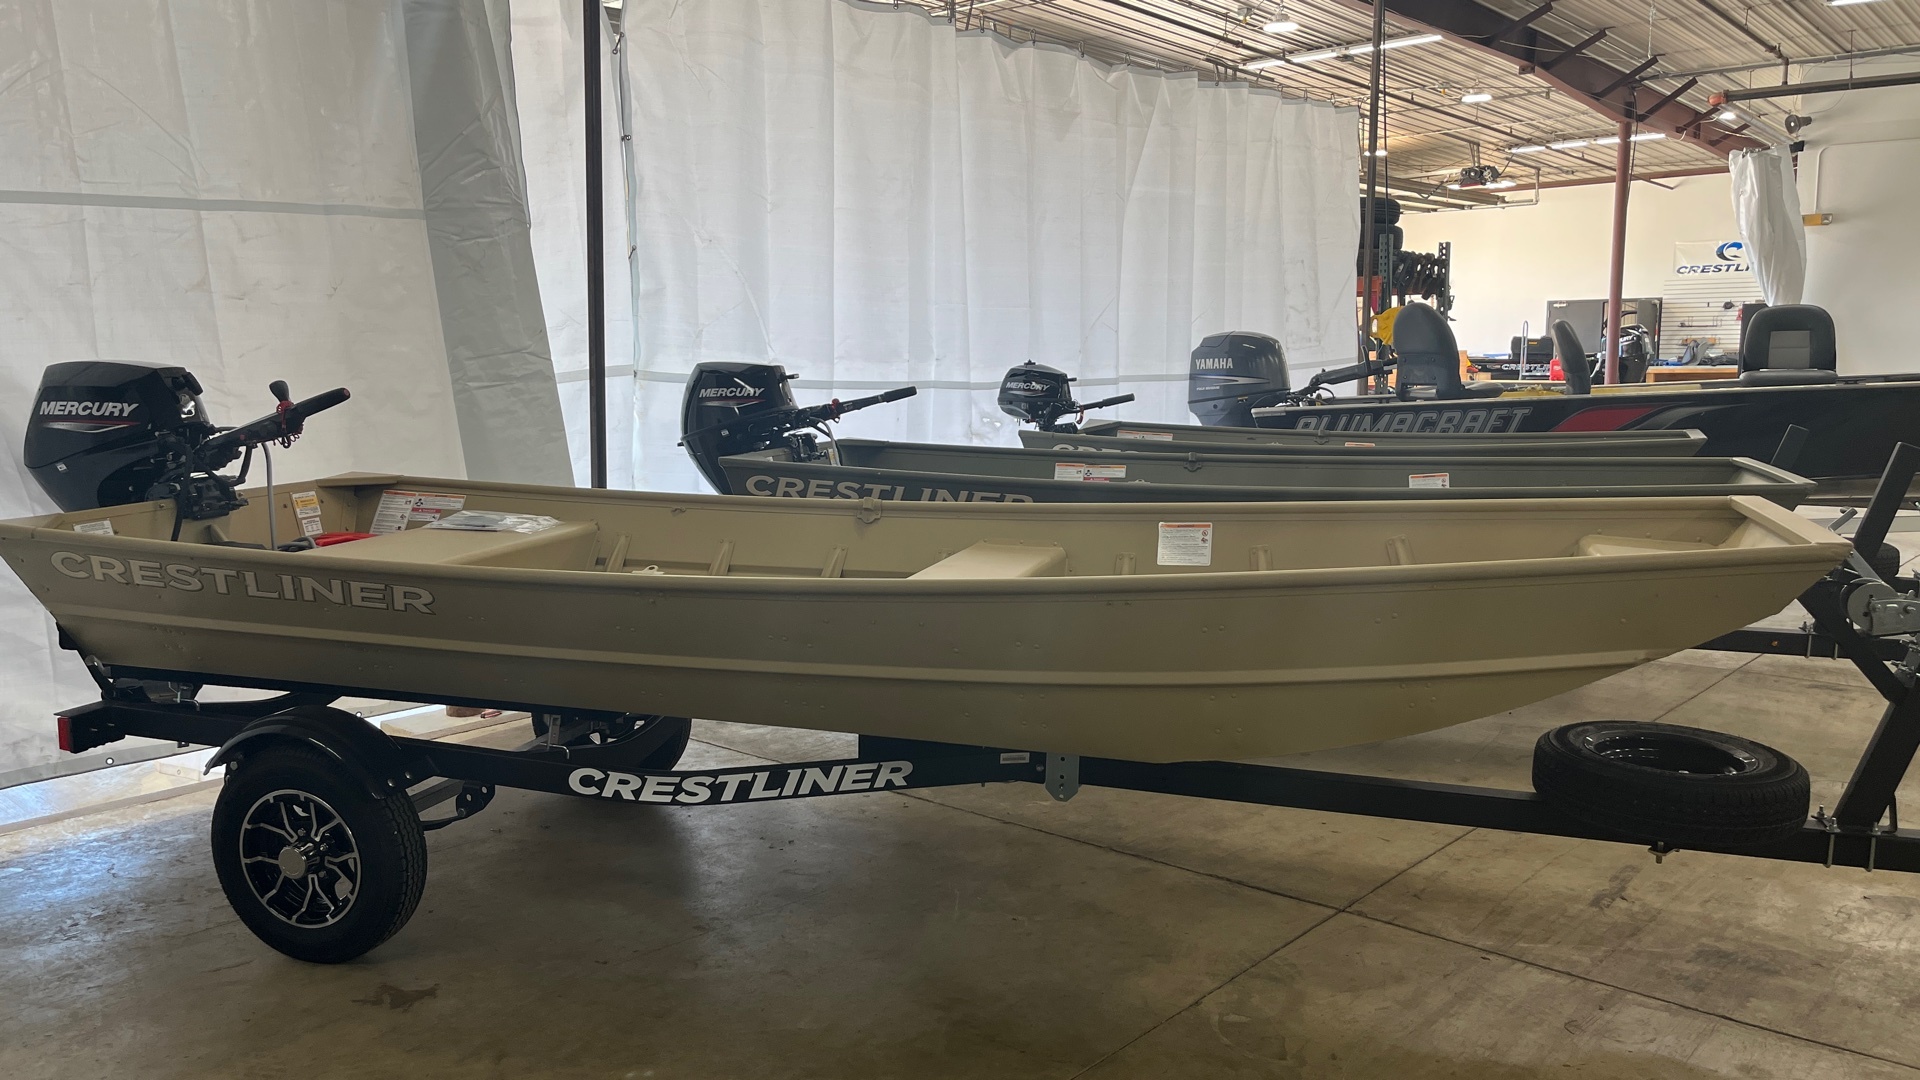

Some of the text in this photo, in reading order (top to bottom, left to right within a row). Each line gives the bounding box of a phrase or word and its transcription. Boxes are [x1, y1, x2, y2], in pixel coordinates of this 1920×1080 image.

[1676, 263, 1750, 275] CRESTLI
[1195, 357, 1233, 370] YAMAHA
[698, 387, 766, 398] MERCURY
[1005, 381, 1051, 391] MERCURY
[39, 401, 139, 417] MERCURY
[50, 550, 436, 615] CRESTLINER
[568, 760, 915, 804] CRESTLINER
